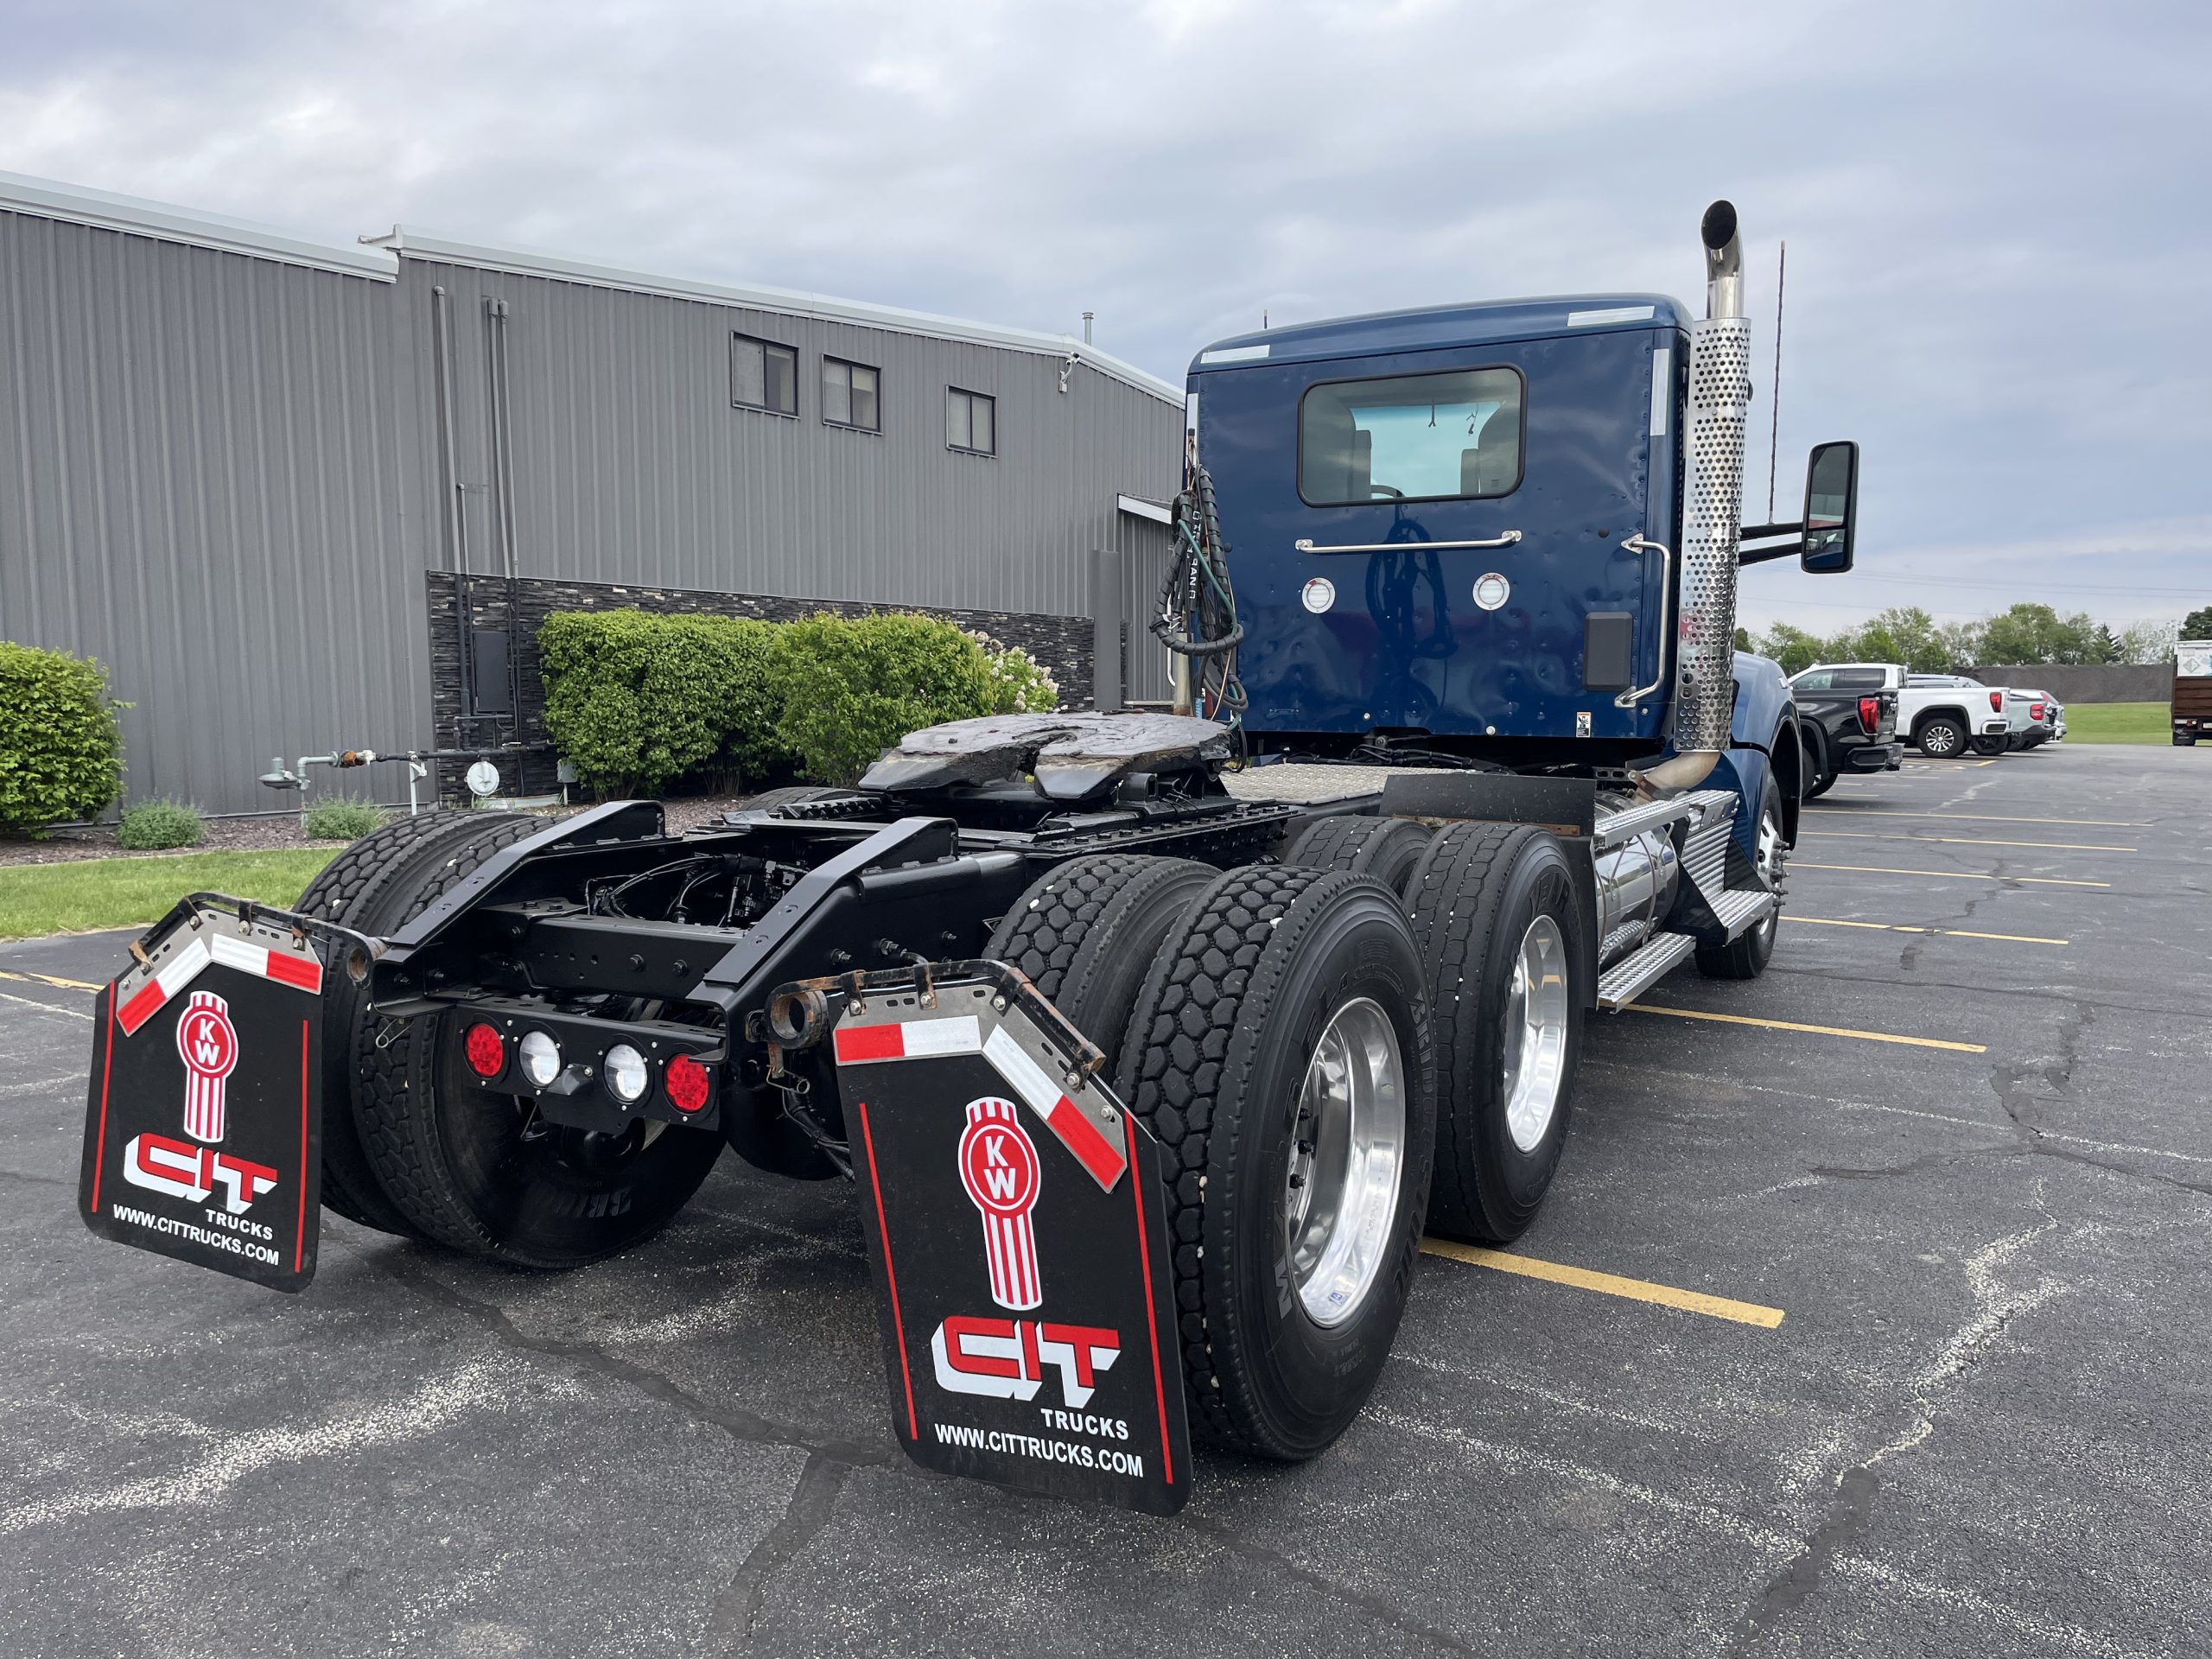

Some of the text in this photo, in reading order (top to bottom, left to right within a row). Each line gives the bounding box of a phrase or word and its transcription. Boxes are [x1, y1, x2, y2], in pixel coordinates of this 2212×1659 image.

[123, 1132, 278, 1216] CIT
[113, 1204, 279, 1266] WWW.CITTRUCKS.COM
[205, 1208, 273, 1241] TRUCKS
[931, 1316, 1122, 1409] CIT
[934, 1423, 1144, 1478] WWW.CITTRUCKS.COM
[1040, 1408, 1129, 1440] TRUCKS
